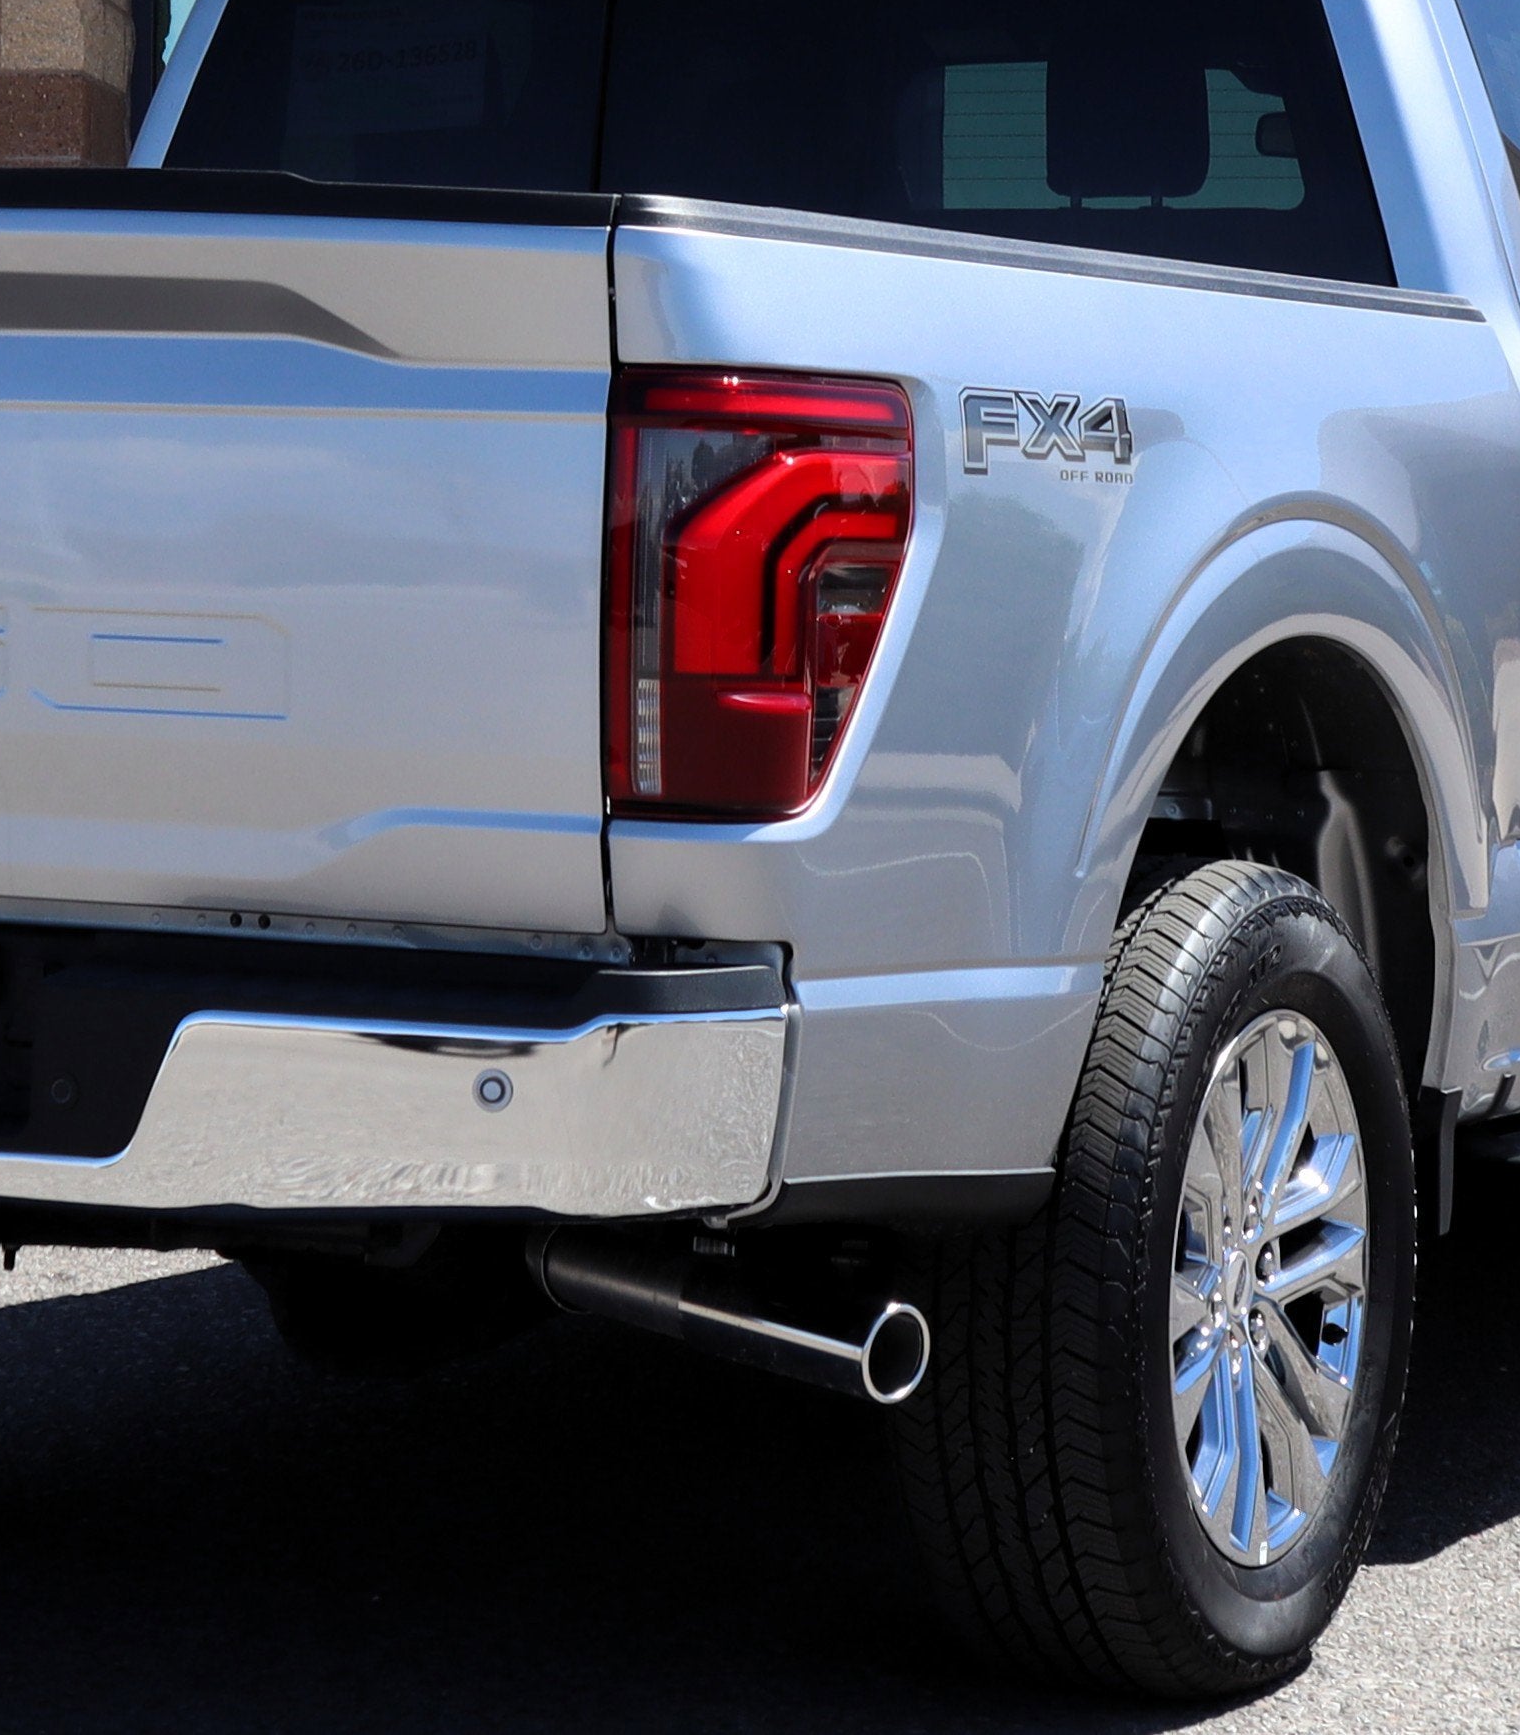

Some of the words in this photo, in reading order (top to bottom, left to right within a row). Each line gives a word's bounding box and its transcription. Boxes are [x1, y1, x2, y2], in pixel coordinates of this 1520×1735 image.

[958, 385, 1133, 476] FX4
[1060, 469, 1089, 482] OFF
[1094, 471, 1134, 485] ROAD
